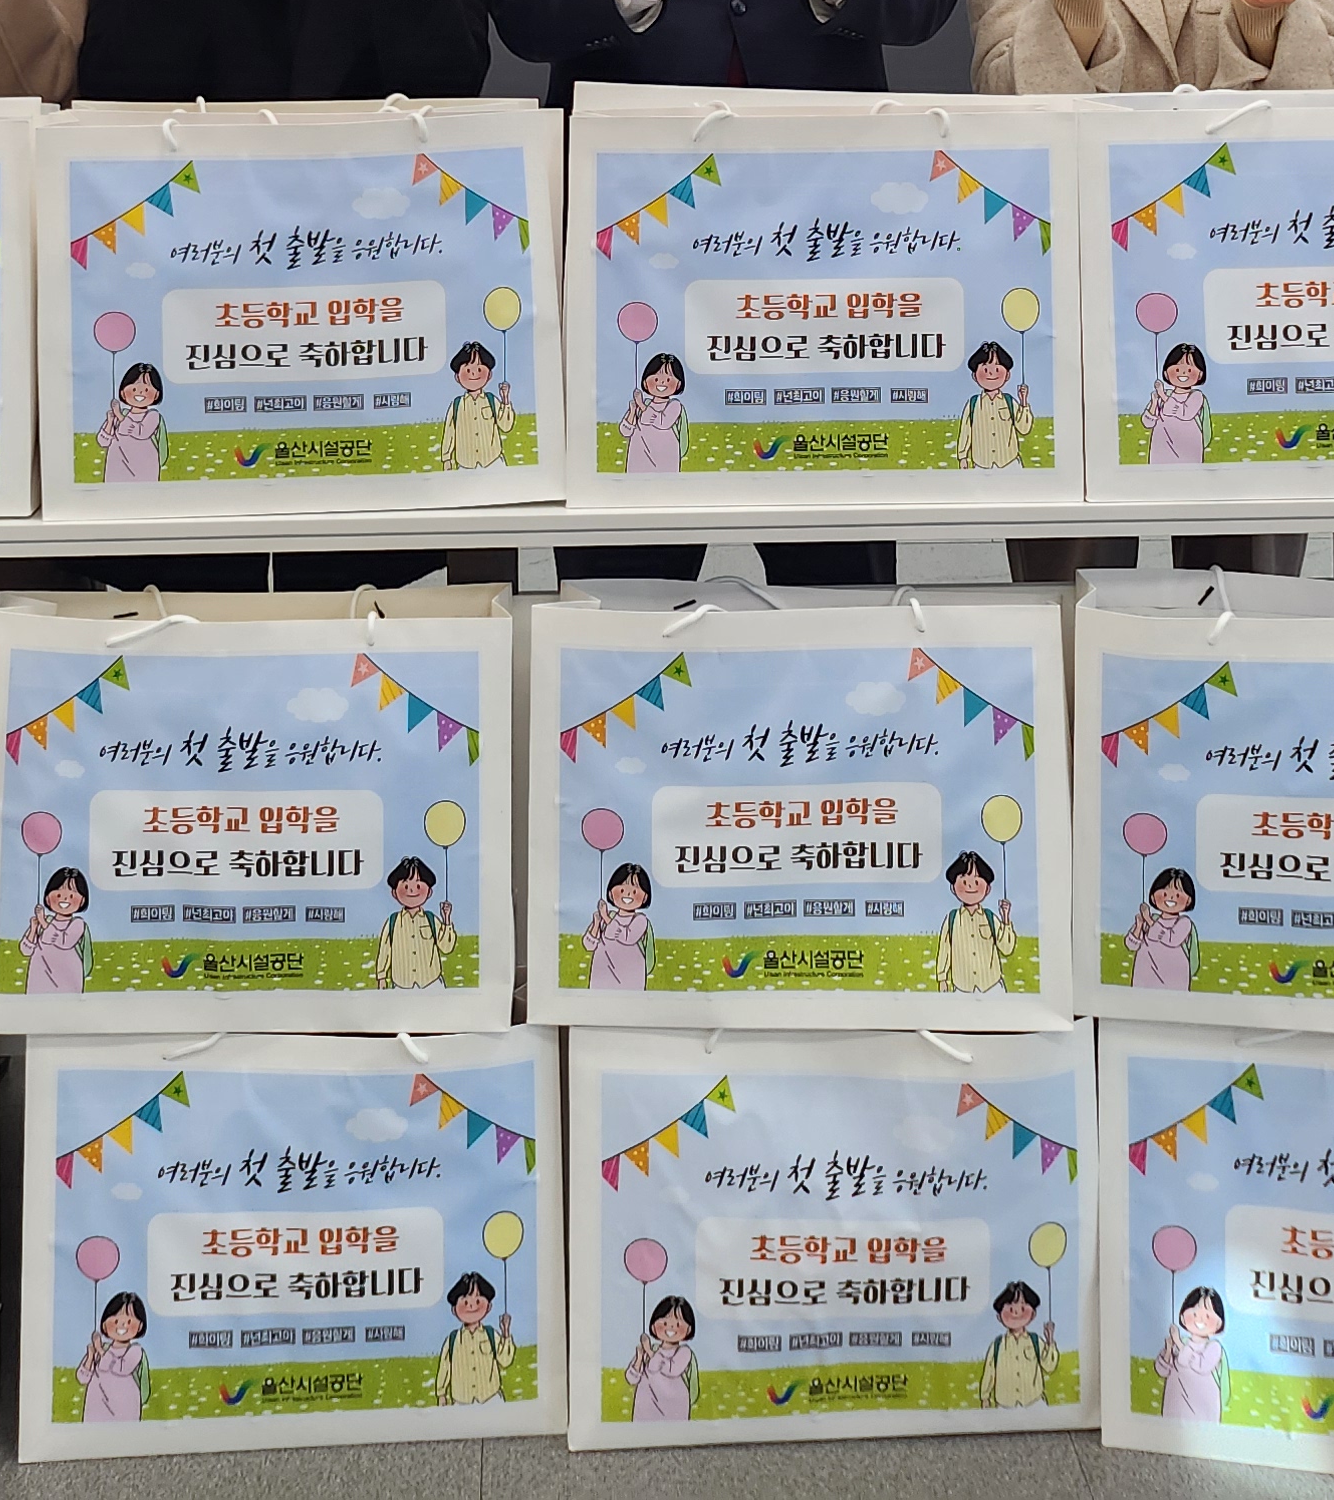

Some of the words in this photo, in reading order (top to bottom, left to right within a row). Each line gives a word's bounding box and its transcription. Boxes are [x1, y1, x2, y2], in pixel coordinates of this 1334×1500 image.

[170, 239, 241, 266] 여러분의
[249, 229, 277, 264] 첫
[286, 225, 346, 270] 출발을
[692, 231, 763, 257] 여러분의
[770, 221, 797, 256] 첫
[806, 218, 865, 262] 출발을
[215, 302, 320, 328] 초등학교
[328, 297, 404, 326] 입학을
[736, 294, 839, 320] 초등학교
[847, 293, 922, 319] 입학을
[707, 336, 810, 361] 진심으로
[818, 333, 946, 360] 축하합니다
[1227, 324, 1330, 350] 진심으로
[185, 344, 291, 370] 진심으로
[299, 337, 428, 367] 축하합니다
[275, 439, 372, 459] 울산시설공단
[793, 433, 889, 452] 울산시설공단
[99, 739, 172, 766] 여러분의
[180, 729, 208, 766] 첫
[217, 726, 280, 773] 출발을
[661, 734, 734, 762] 여러분의
[742, 724, 770, 761] 첫
[779, 720, 840, 767] 출발을
[143, 806, 251, 833] 초등학교
[260, 806, 339, 834] 입학을
[706, 801, 812, 828] 초등학교
[821, 798, 898, 826] 입학을
[112, 850, 220, 877] 진심으로
[228, 849, 364, 877] 축하합니다
[675, 846, 782, 873] 진심으로
[790, 841, 923, 870] 축하합니다
[1220, 852, 1331, 881] 진심으로
[203, 952, 304, 972] 울산시설공단
[763, 950, 864, 970] 울산시설공단
[156, 1159, 231, 1187] 여러분의
[239, 1149, 267, 1187] 첫
[277, 1146, 339, 1194] 출발을
[202, 1228, 310, 1256] 초등학교
[319, 1225, 399, 1255] 입학을
[750, 1235, 859, 1264] 초등학교
[868, 1236, 946, 1263] 입학을
[170, 1273, 280, 1301] 진심으로
[288, 1267, 424, 1299] 축하합니다
[719, 1279, 828, 1306] 진심으로
[836, 1277, 970, 1305] 축하합니다
[261, 1373, 363, 1395] 울산시설공단
